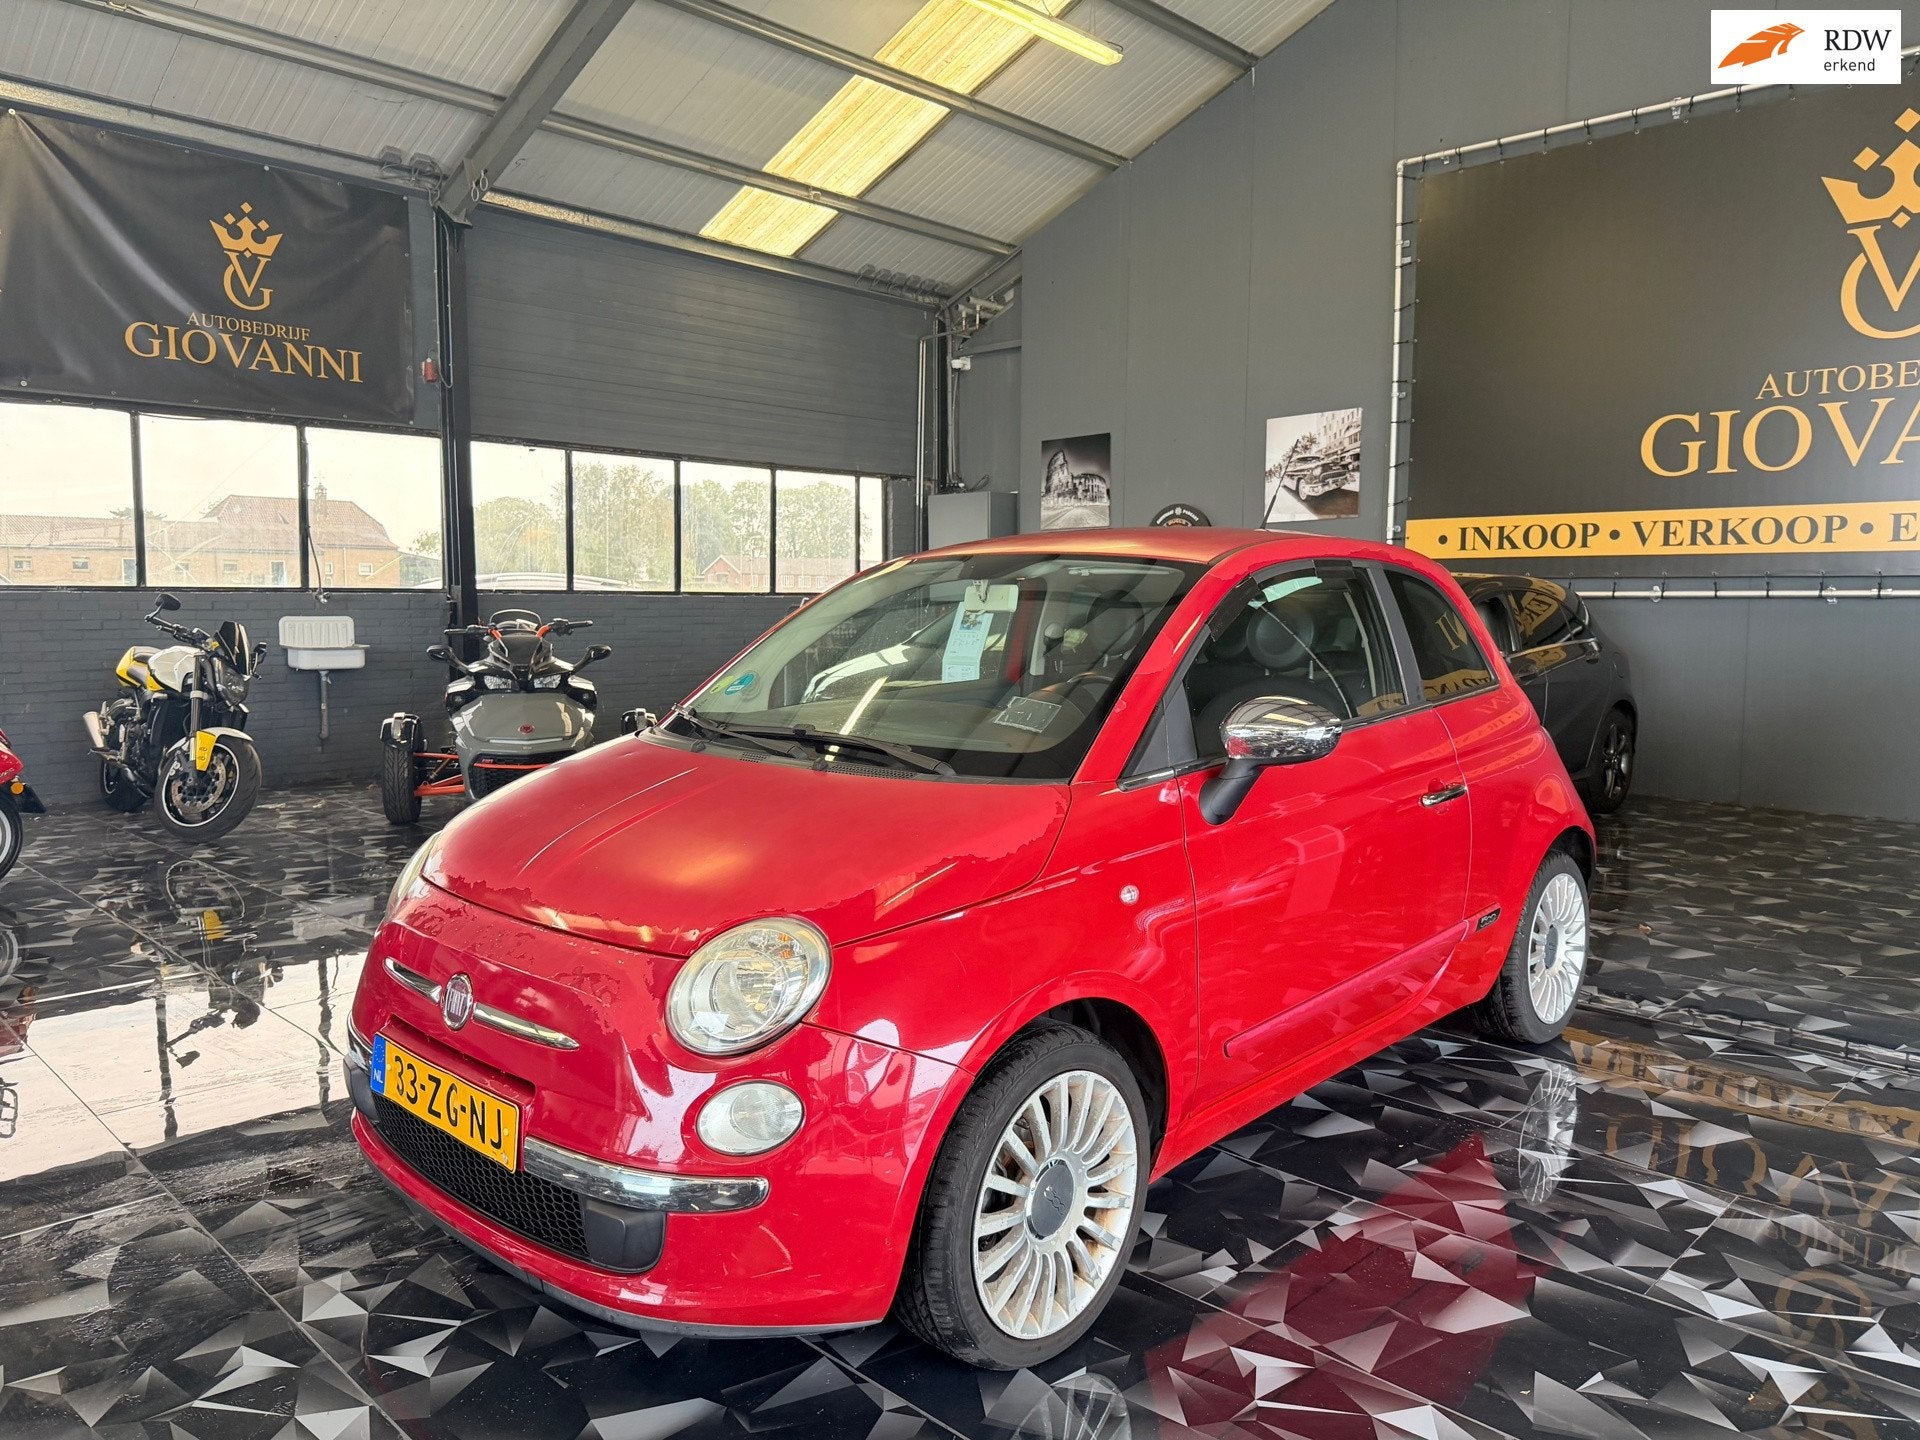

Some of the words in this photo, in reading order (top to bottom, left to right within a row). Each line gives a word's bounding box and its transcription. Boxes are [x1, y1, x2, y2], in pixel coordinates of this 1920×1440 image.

[186, 311, 311, 342] AUTOBEDRIJF
[125, 322, 363, 383] GIOVANNI
[1755, 359, 1920, 401] AUTOBE
[1458, 522, 1600, 552] INKOOP
[1631, 514, 1848, 548] VERKOOP
[373, 1069, 384, 1084] NL
[394, 1055, 503, 1150] 33-ZG-NJ
